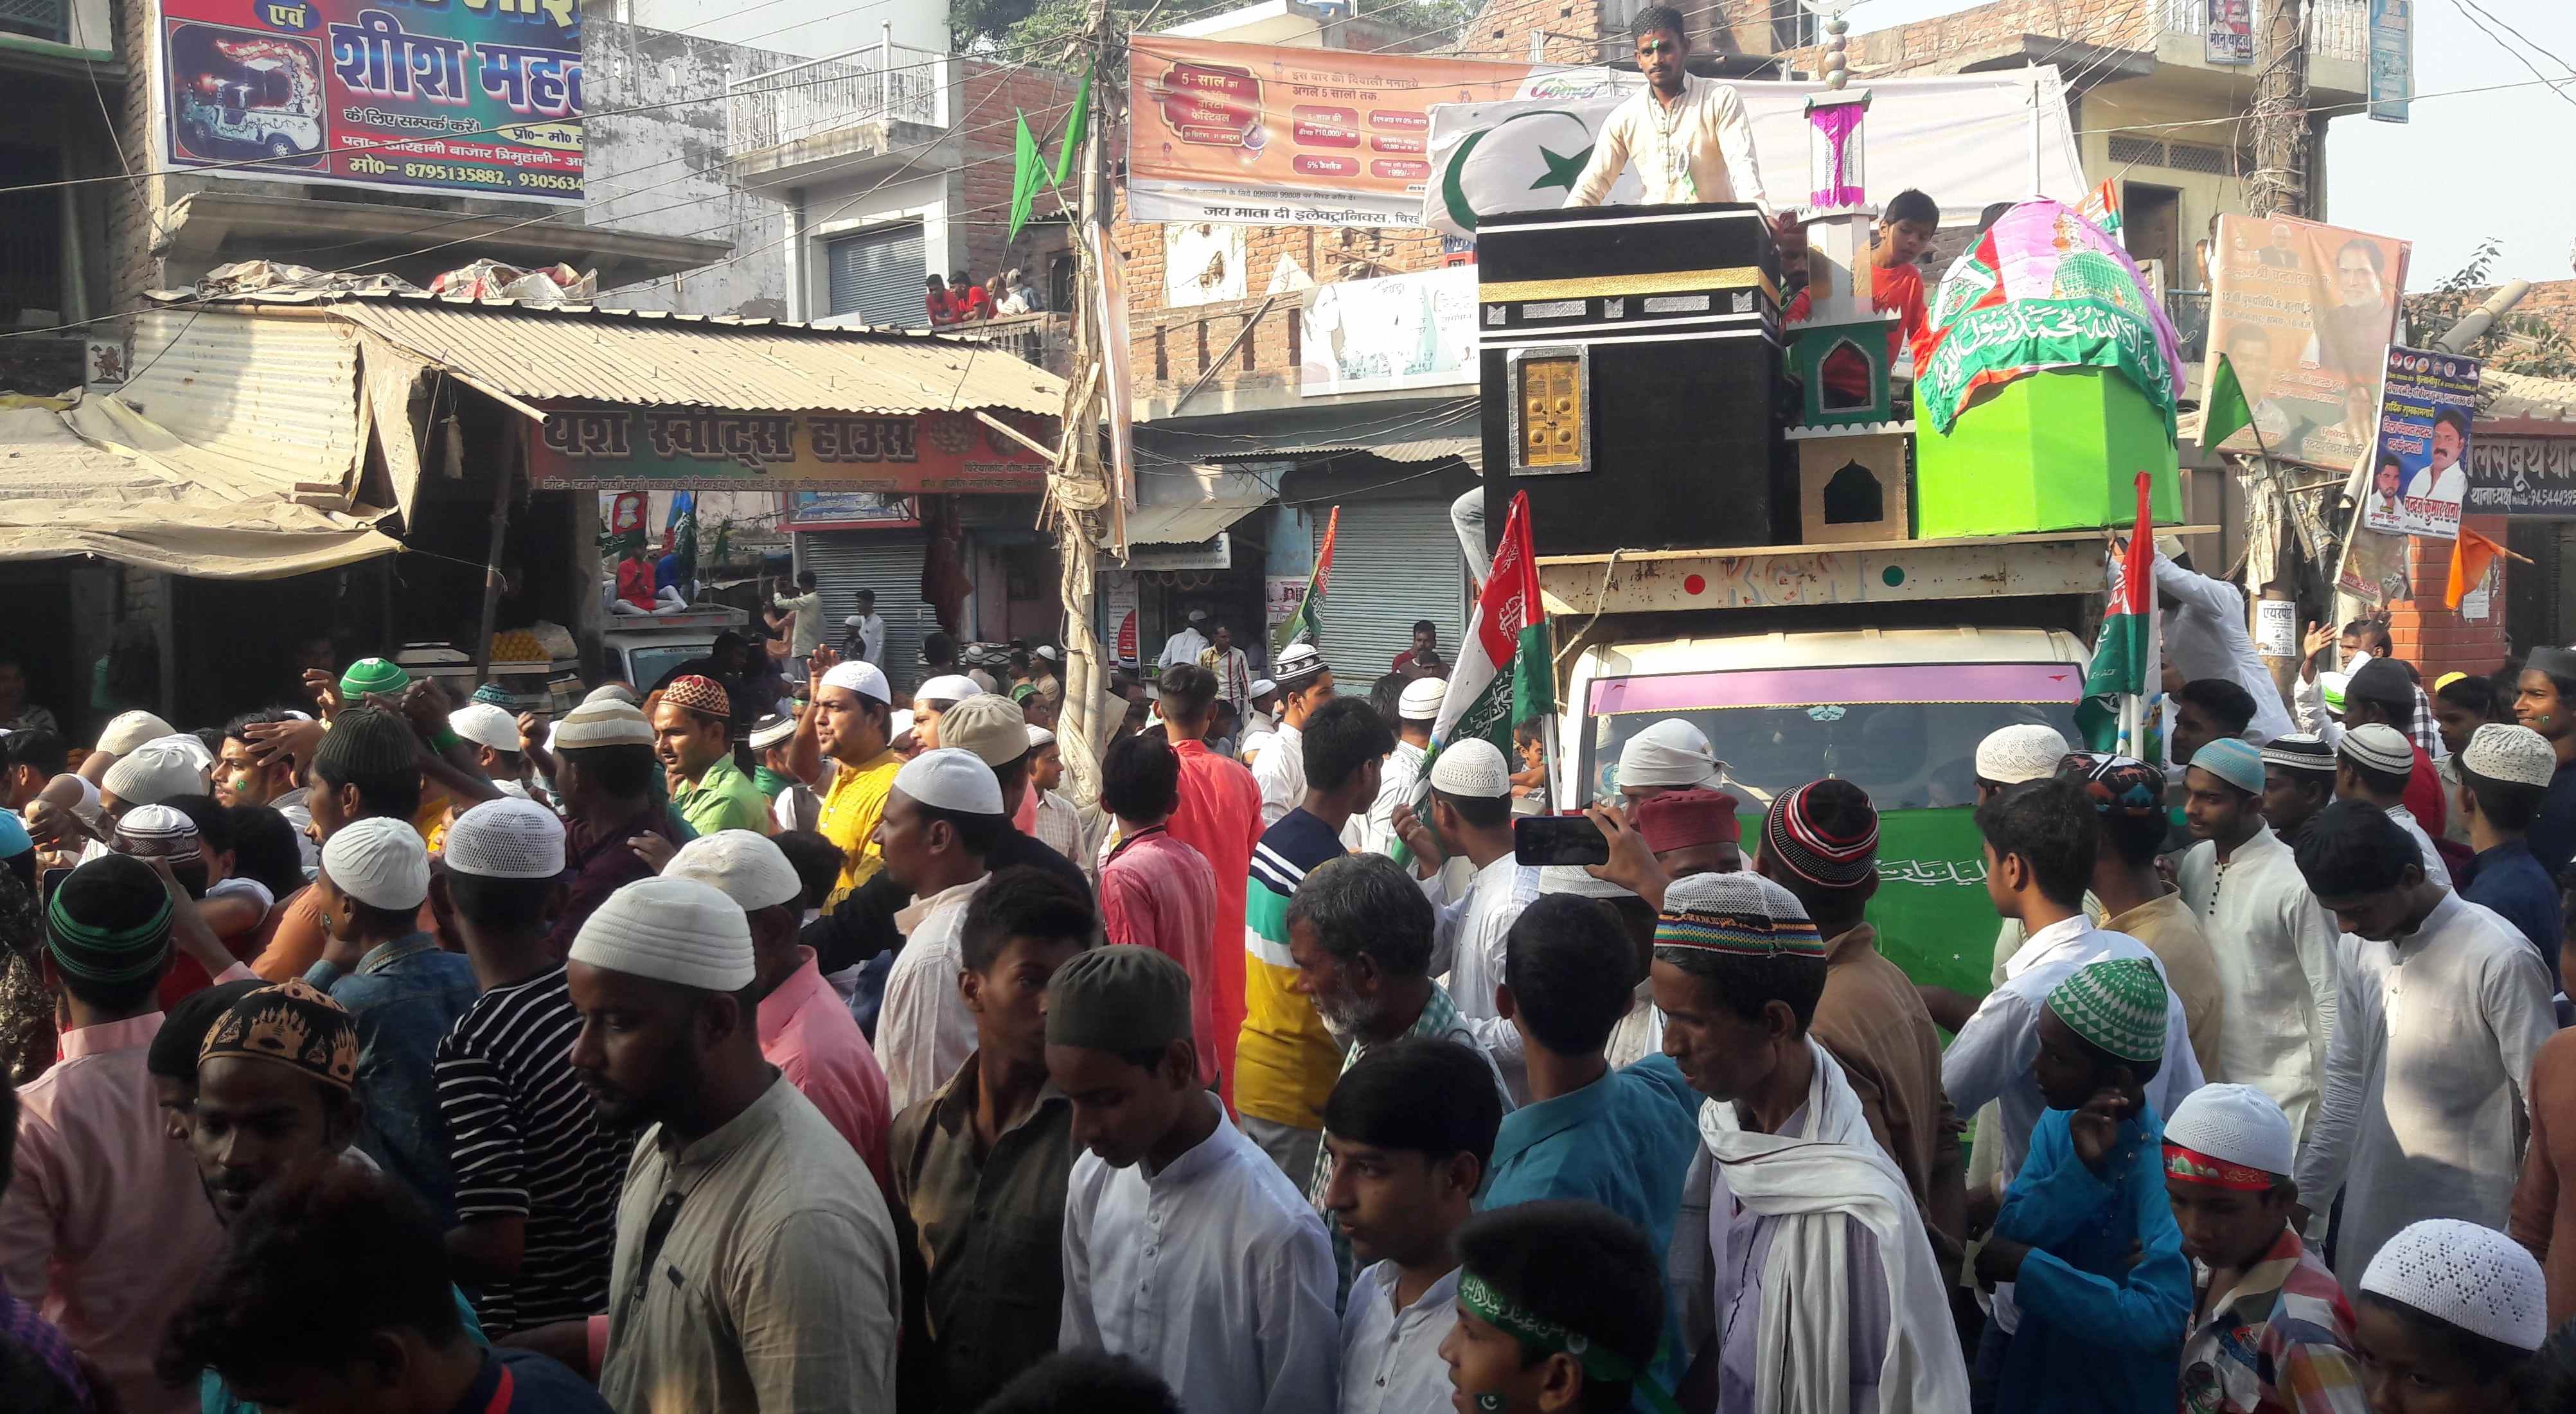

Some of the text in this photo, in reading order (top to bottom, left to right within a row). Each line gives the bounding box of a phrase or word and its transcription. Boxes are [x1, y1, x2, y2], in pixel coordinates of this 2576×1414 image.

[267, 3, 307, 28] एवं
[328, 9, 583, 116] शीश मह
[1322, 88, 1328, 98] 5
[343, 106, 362, 123] के
[364, 107, 398, 127] लिए
[398, 110, 449, 131] सम्पर्क
[1204, 205, 1232, 218] जय
[1234, 206, 1270, 219] माता
[1273, 204, 1290, 220] दी
[542, 406, 919, 474] यश स्वीट्स हाउस
